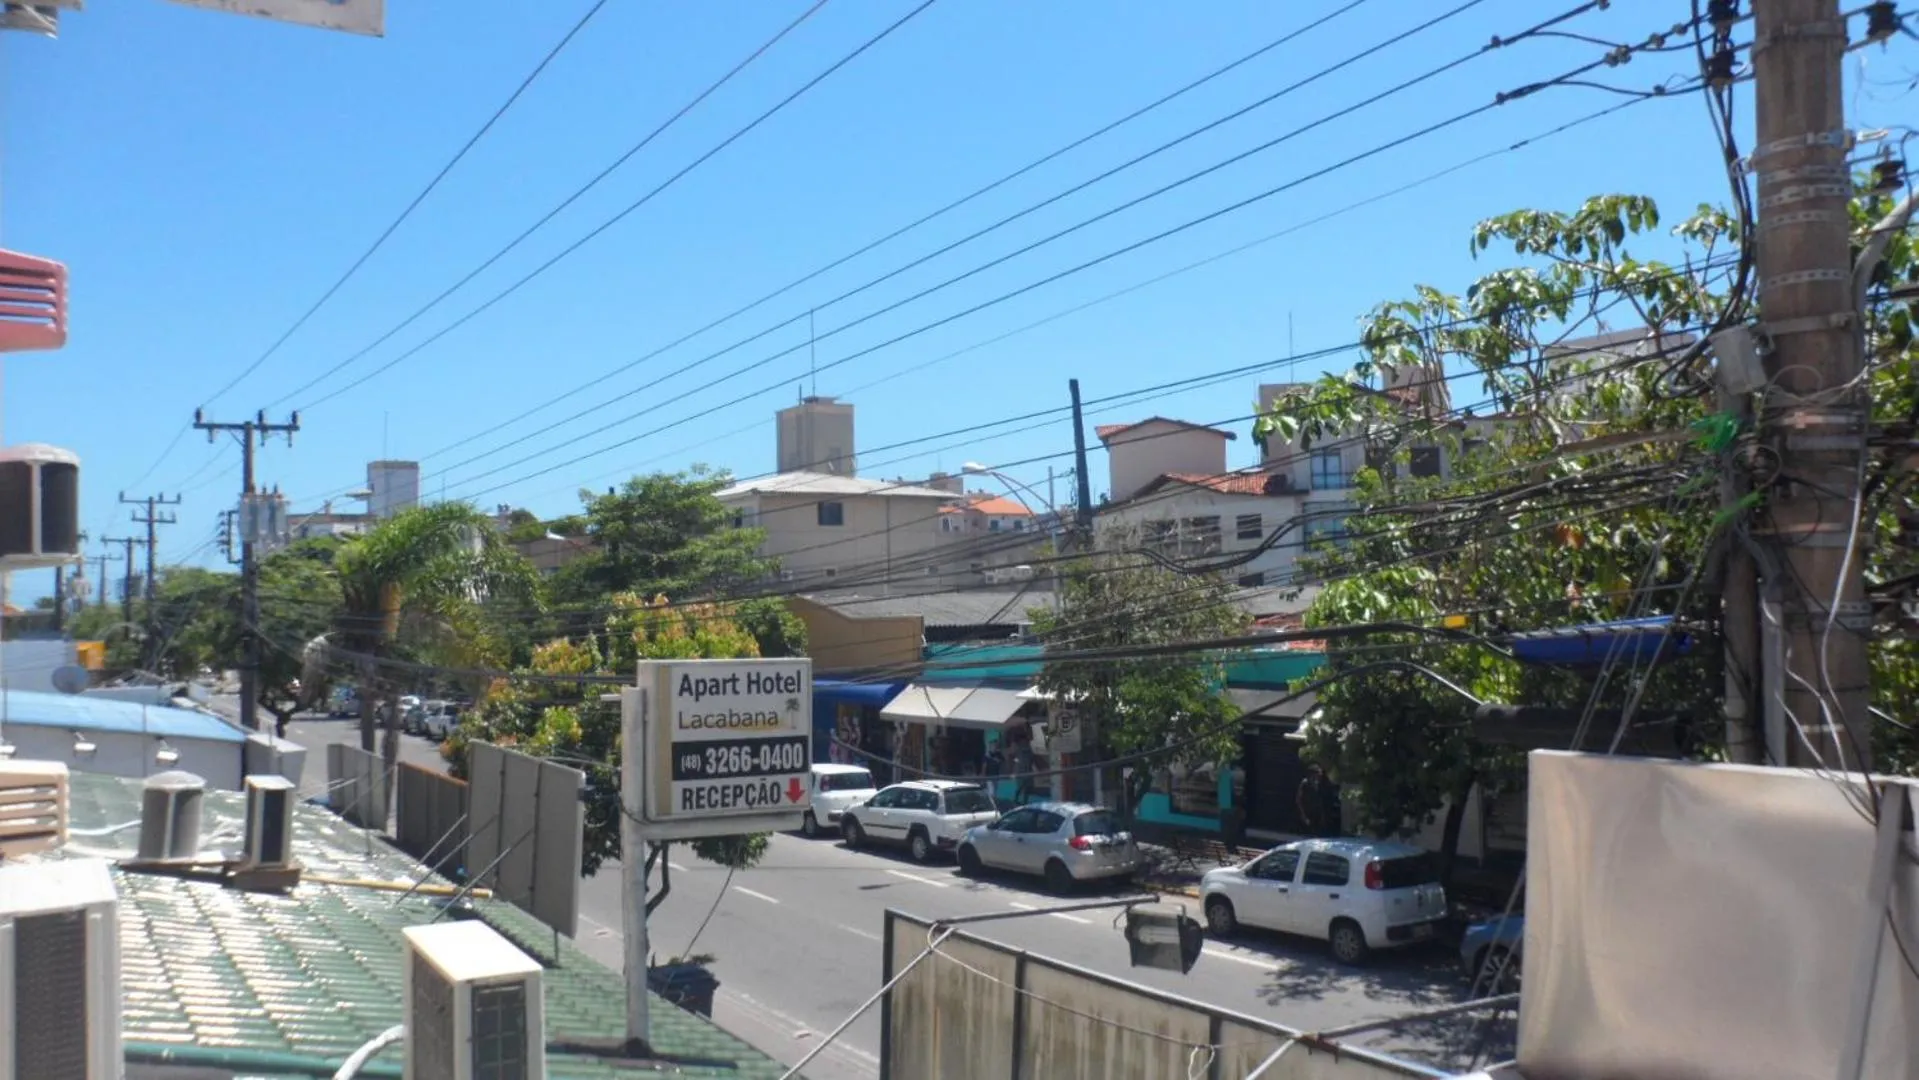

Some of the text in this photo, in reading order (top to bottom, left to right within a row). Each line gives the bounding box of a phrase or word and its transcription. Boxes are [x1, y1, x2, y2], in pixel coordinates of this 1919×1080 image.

[679, 670, 801, 702] Apart Hotel
[678, 708, 778, 729] Lacabana
[681, 743, 803, 774] (48) 3266-0400
[682, 778, 781, 810] RECEPÇÃO
